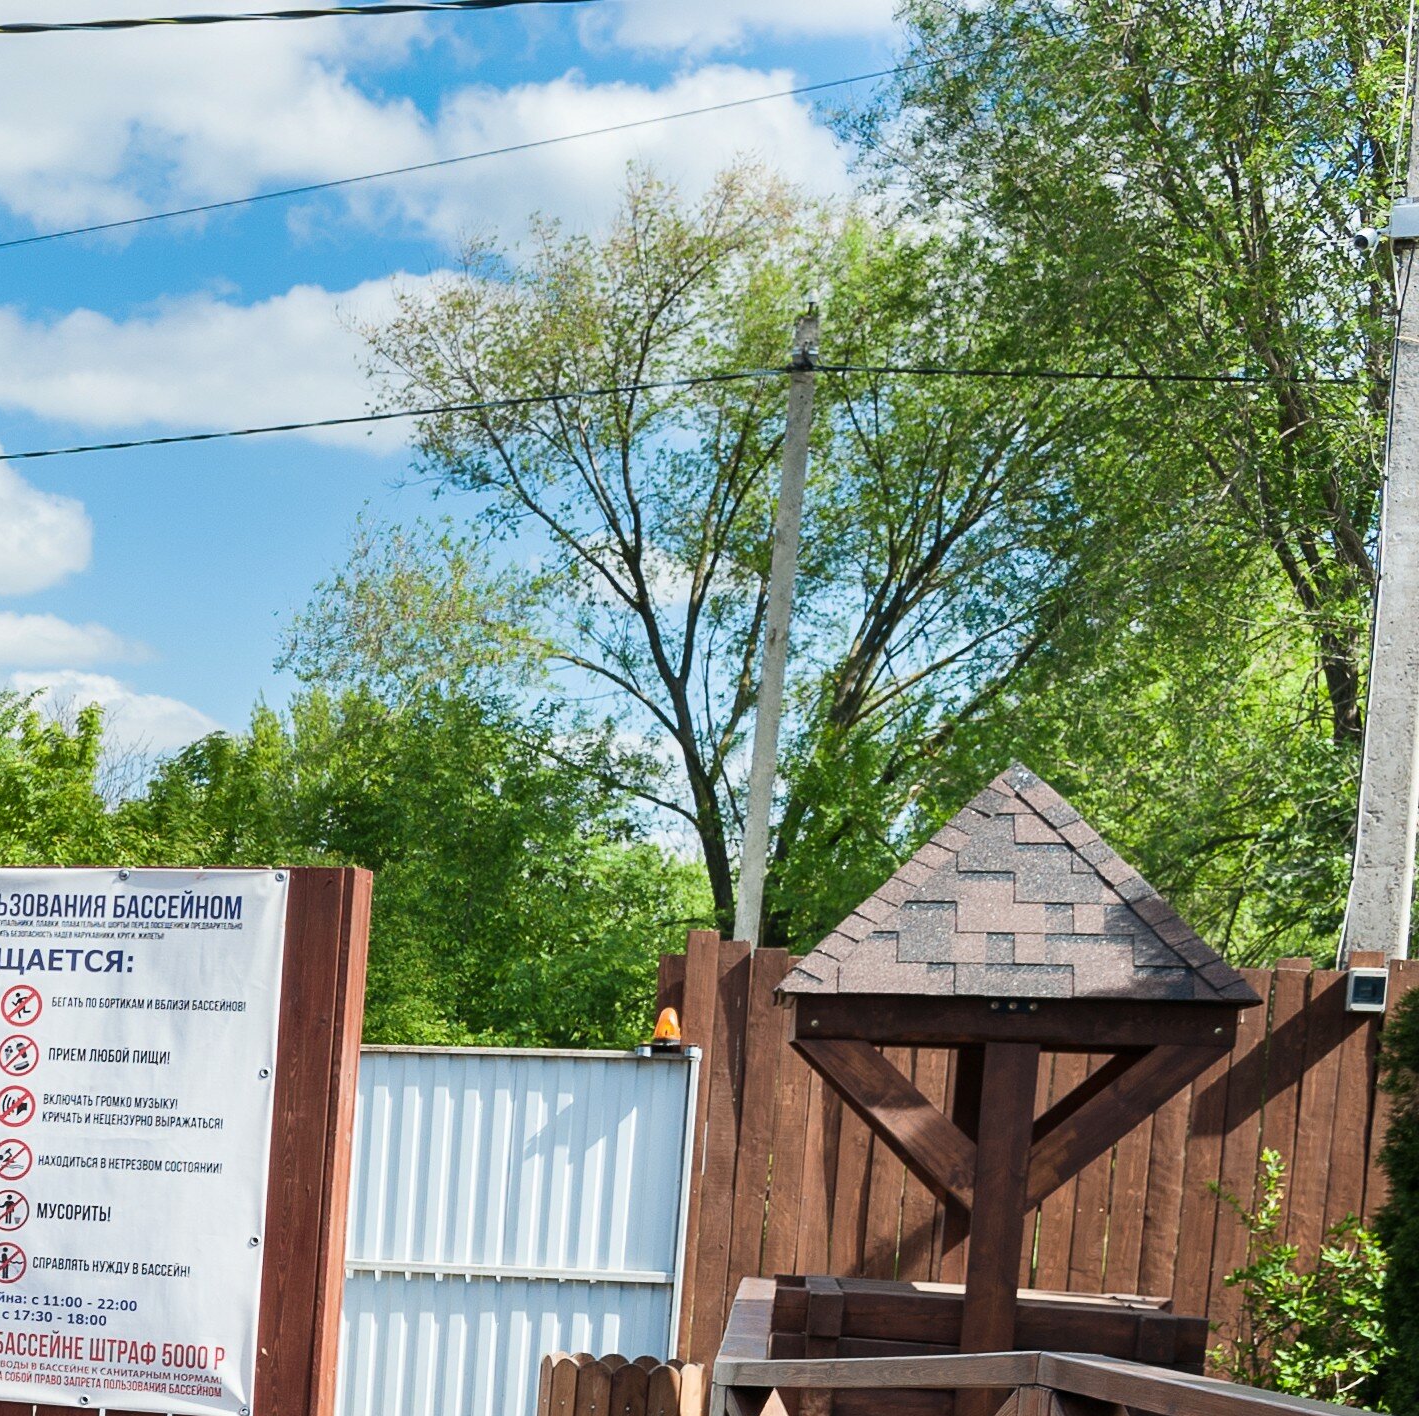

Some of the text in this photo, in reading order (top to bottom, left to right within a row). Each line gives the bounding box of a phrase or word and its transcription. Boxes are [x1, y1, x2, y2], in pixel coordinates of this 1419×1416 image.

[113, 891, 242, 920] БАССЕЙНОМ
[51, 997, 246, 1012] БЕГАТЬ ПО БОРТИКАМ И ВБЛИЗИ БАССЕЙНОВ!
[48, 1048, 170, 1064] ПРИЕМ ЛЮБОЙ ПИЩИ!
[43, 1094, 178, 1109] ВКЛЮЧАТЬ ГРОМКО МУЗЫКУ!
[42, 1112, 223, 1130] КРИЧАТЬ И НЕЦЕНЗУРНО ВЫРАЖАТЬСЯ!
[38, 1155, 222, 1174] НАХОДИТЬСЯ В НЕТРЕЗВОМ СОСТОЯНИИ!
[37, 1202, 111, 1222] МУСОРИТЬ!
[32, 1257, 190, 1277] СПРАВЛЯТЬ НУЖДУ В БАССЕЙН!
[32, 1296, 39, 1306] с
[43, 1294, 83, 1308] 11:00
[97, 1297, 137, 1311] 22:00
[2, 1310, 9, 1319] с
[14, 1308, 53, 1323] 17:30
[68, 1312, 107, 1326] 18:00
[89, 1337, 156, 1364] ШТРАФ
[162, 1342, 208, 1368] 5000
[214, 1346, 225, 1369] Р
[0, 1360, 29, 1369] ВОДЫ
[31, 1362, 37, 1370] В
[39, 1363, 89, 1374] БАССЕЙНЕ
[91, 1367, 98, 1375] К
[99, 1368, 171, 1380] САНИТАРНЫМ
[173, 1373, 222, 1384] НОРМАМ!
[5, 1371, 32, 1383] СОБОЙ
[34, 1373, 62, 1385] ПРАВО
[63, 1375, 101, 1388] ЗАПРЕТА
[103, 1378, 167, 1393] ПОЛЬЗОВАНИЯ
[168, 1383, 222, 1397] БАССЕЙНОМ
